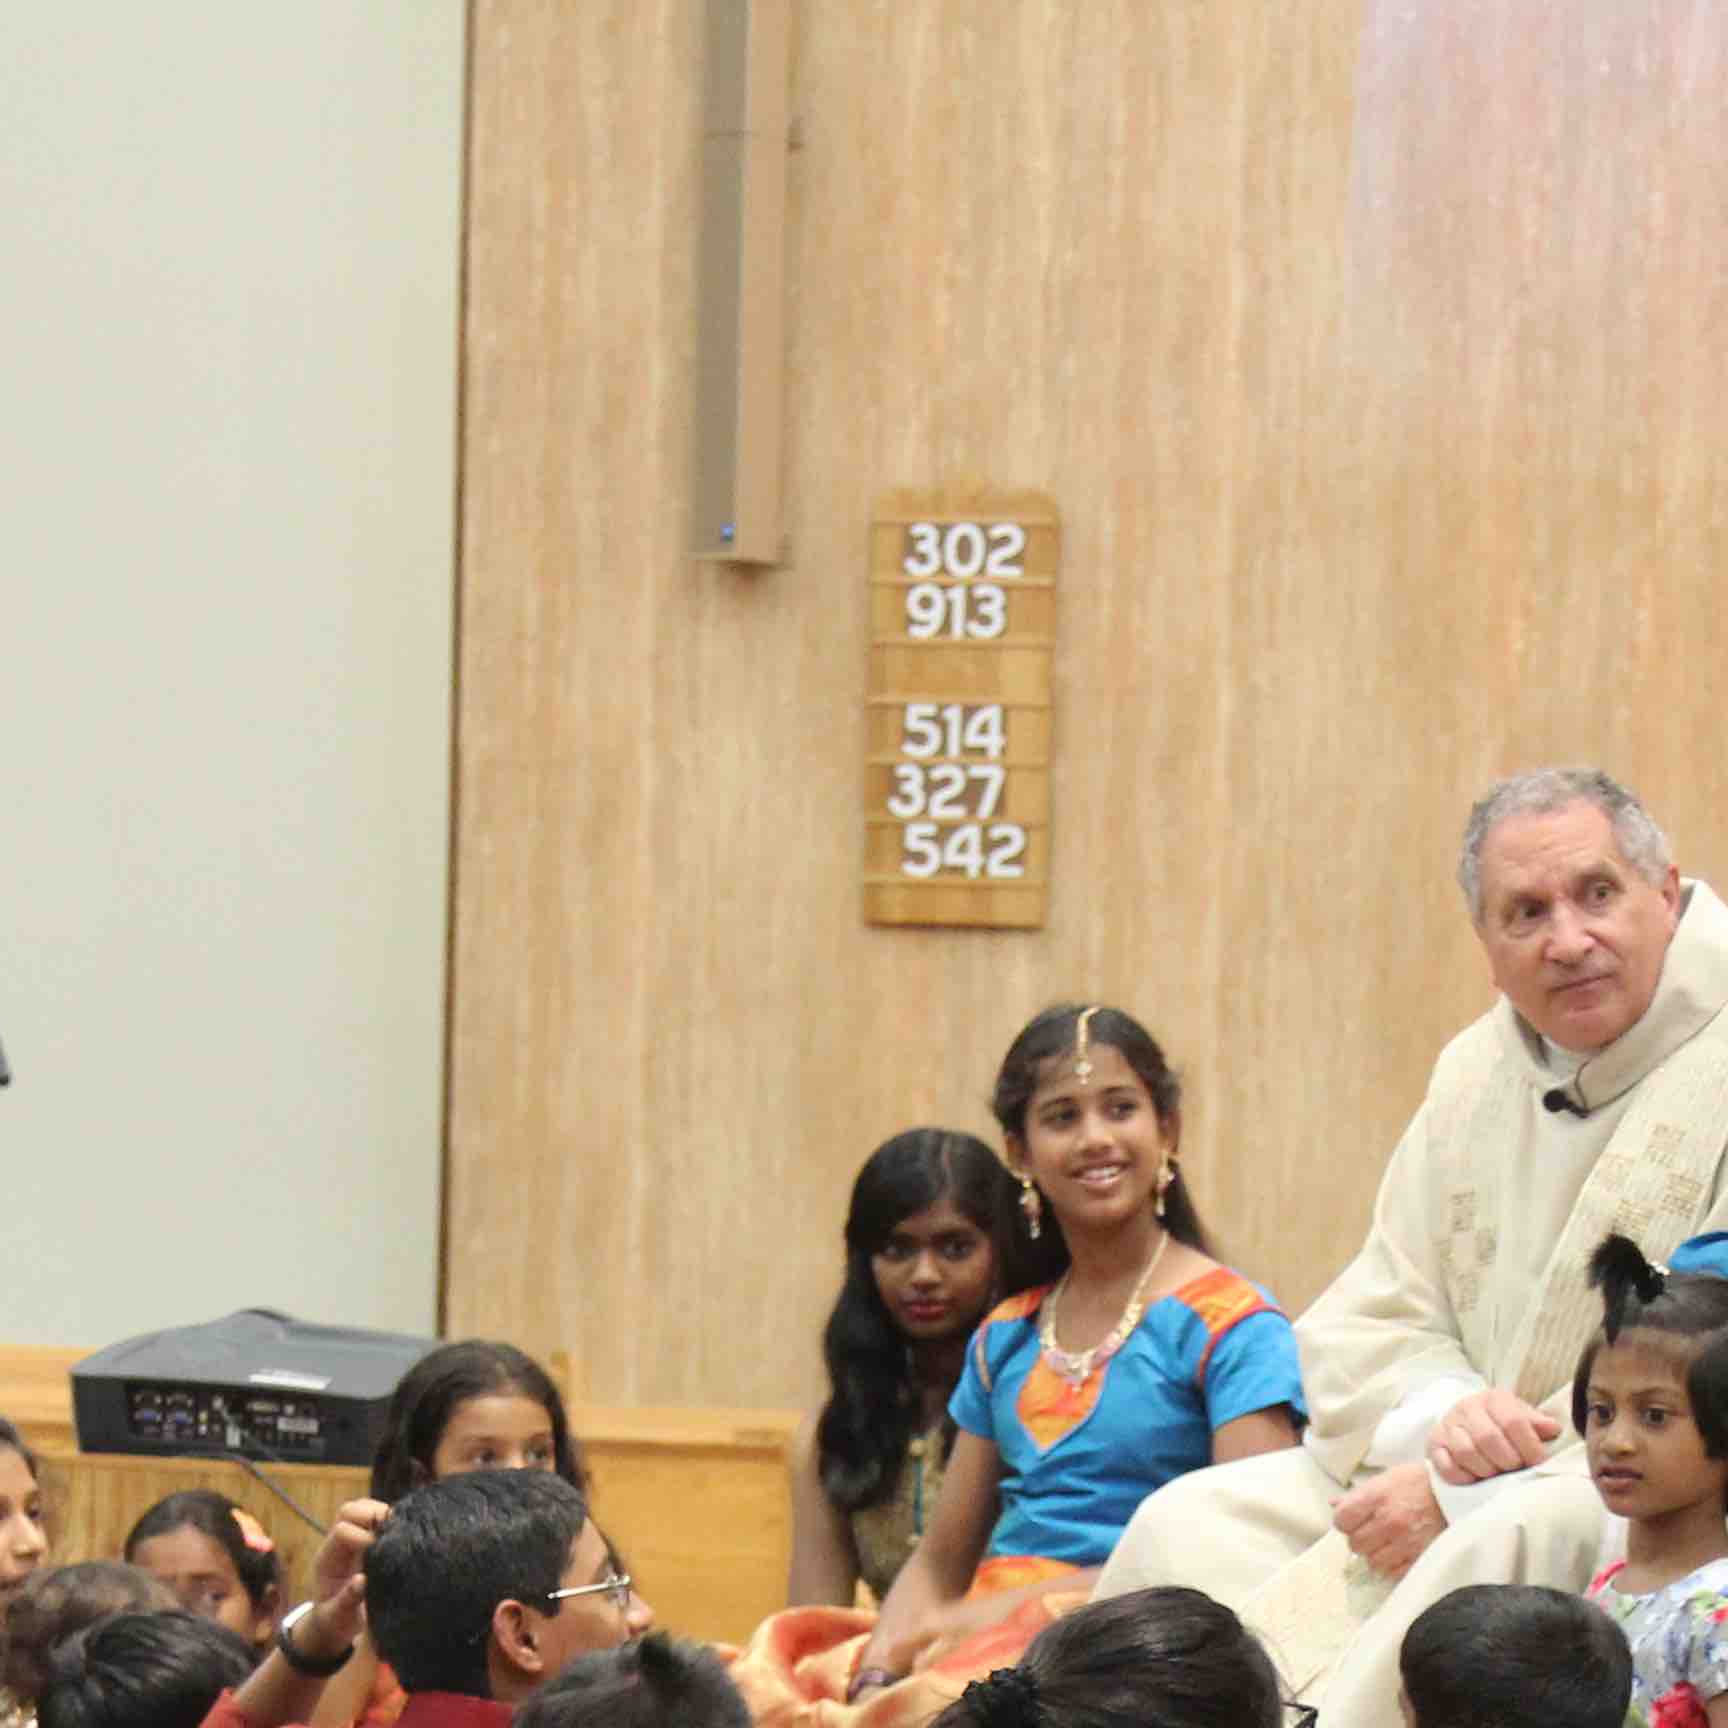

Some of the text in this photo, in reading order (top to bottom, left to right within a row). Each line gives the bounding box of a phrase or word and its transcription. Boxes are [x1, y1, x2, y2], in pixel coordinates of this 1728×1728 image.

[904, 521, 1025, 578] 302
[906, 583, 1007, 639] 913
[901, 703, 1006, 758] 514
[887, 764, 1005, 819] 327
[901, 823, 1025, 878] 542
